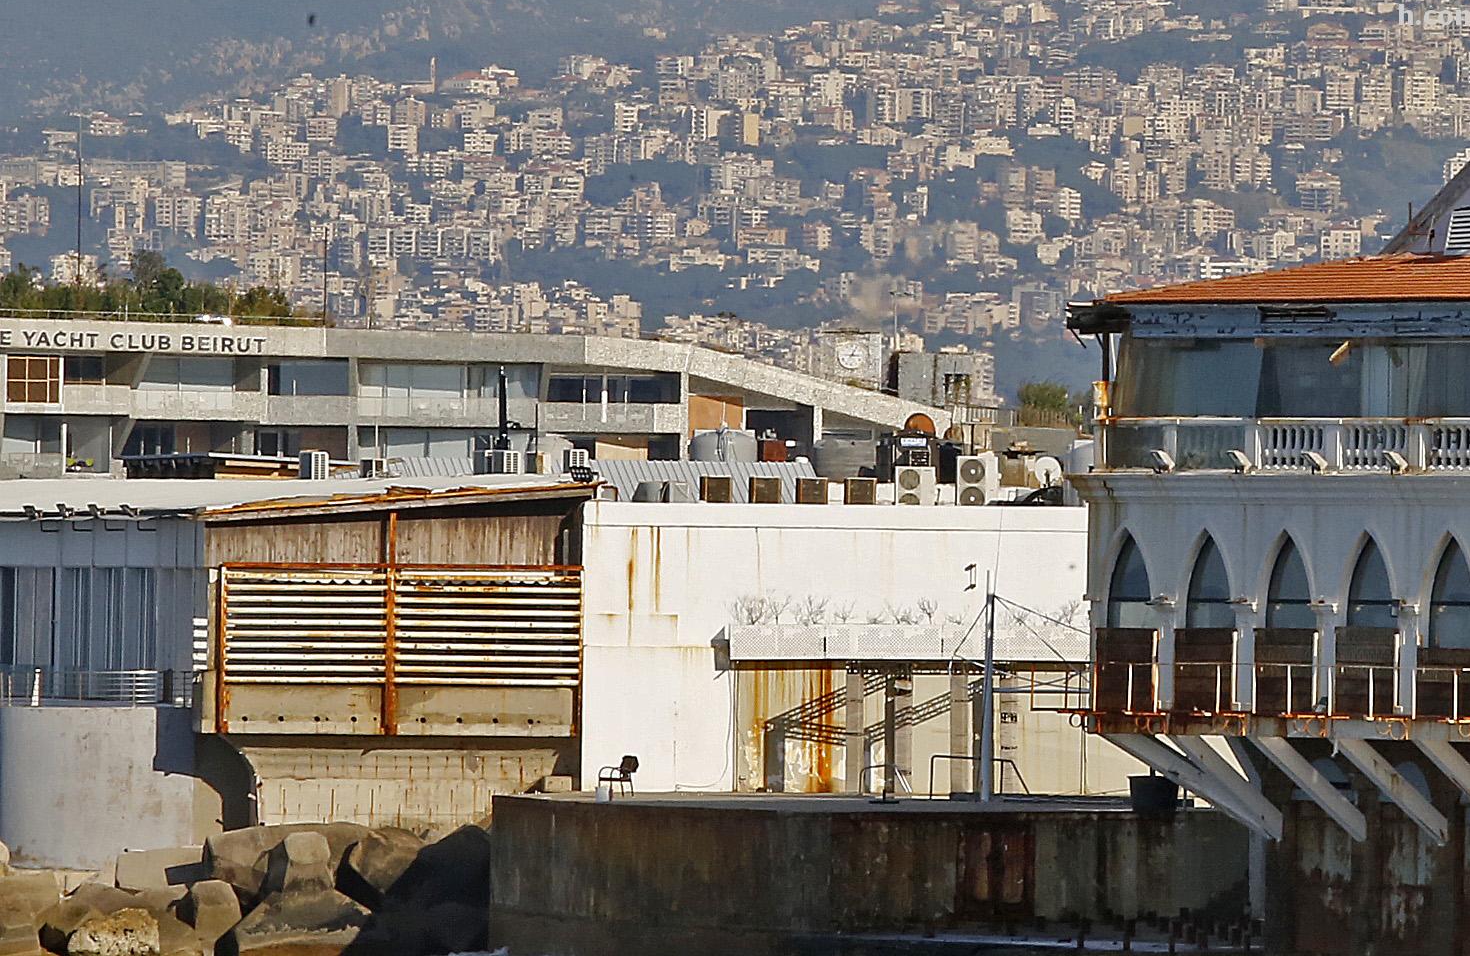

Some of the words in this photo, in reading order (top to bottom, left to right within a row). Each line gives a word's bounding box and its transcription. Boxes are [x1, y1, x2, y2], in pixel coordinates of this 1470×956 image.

[23, 331, 99, 348] YACHT
[110, 334, 171, 351] CLUB
[182, 336, 267, 354] BEIRUT
